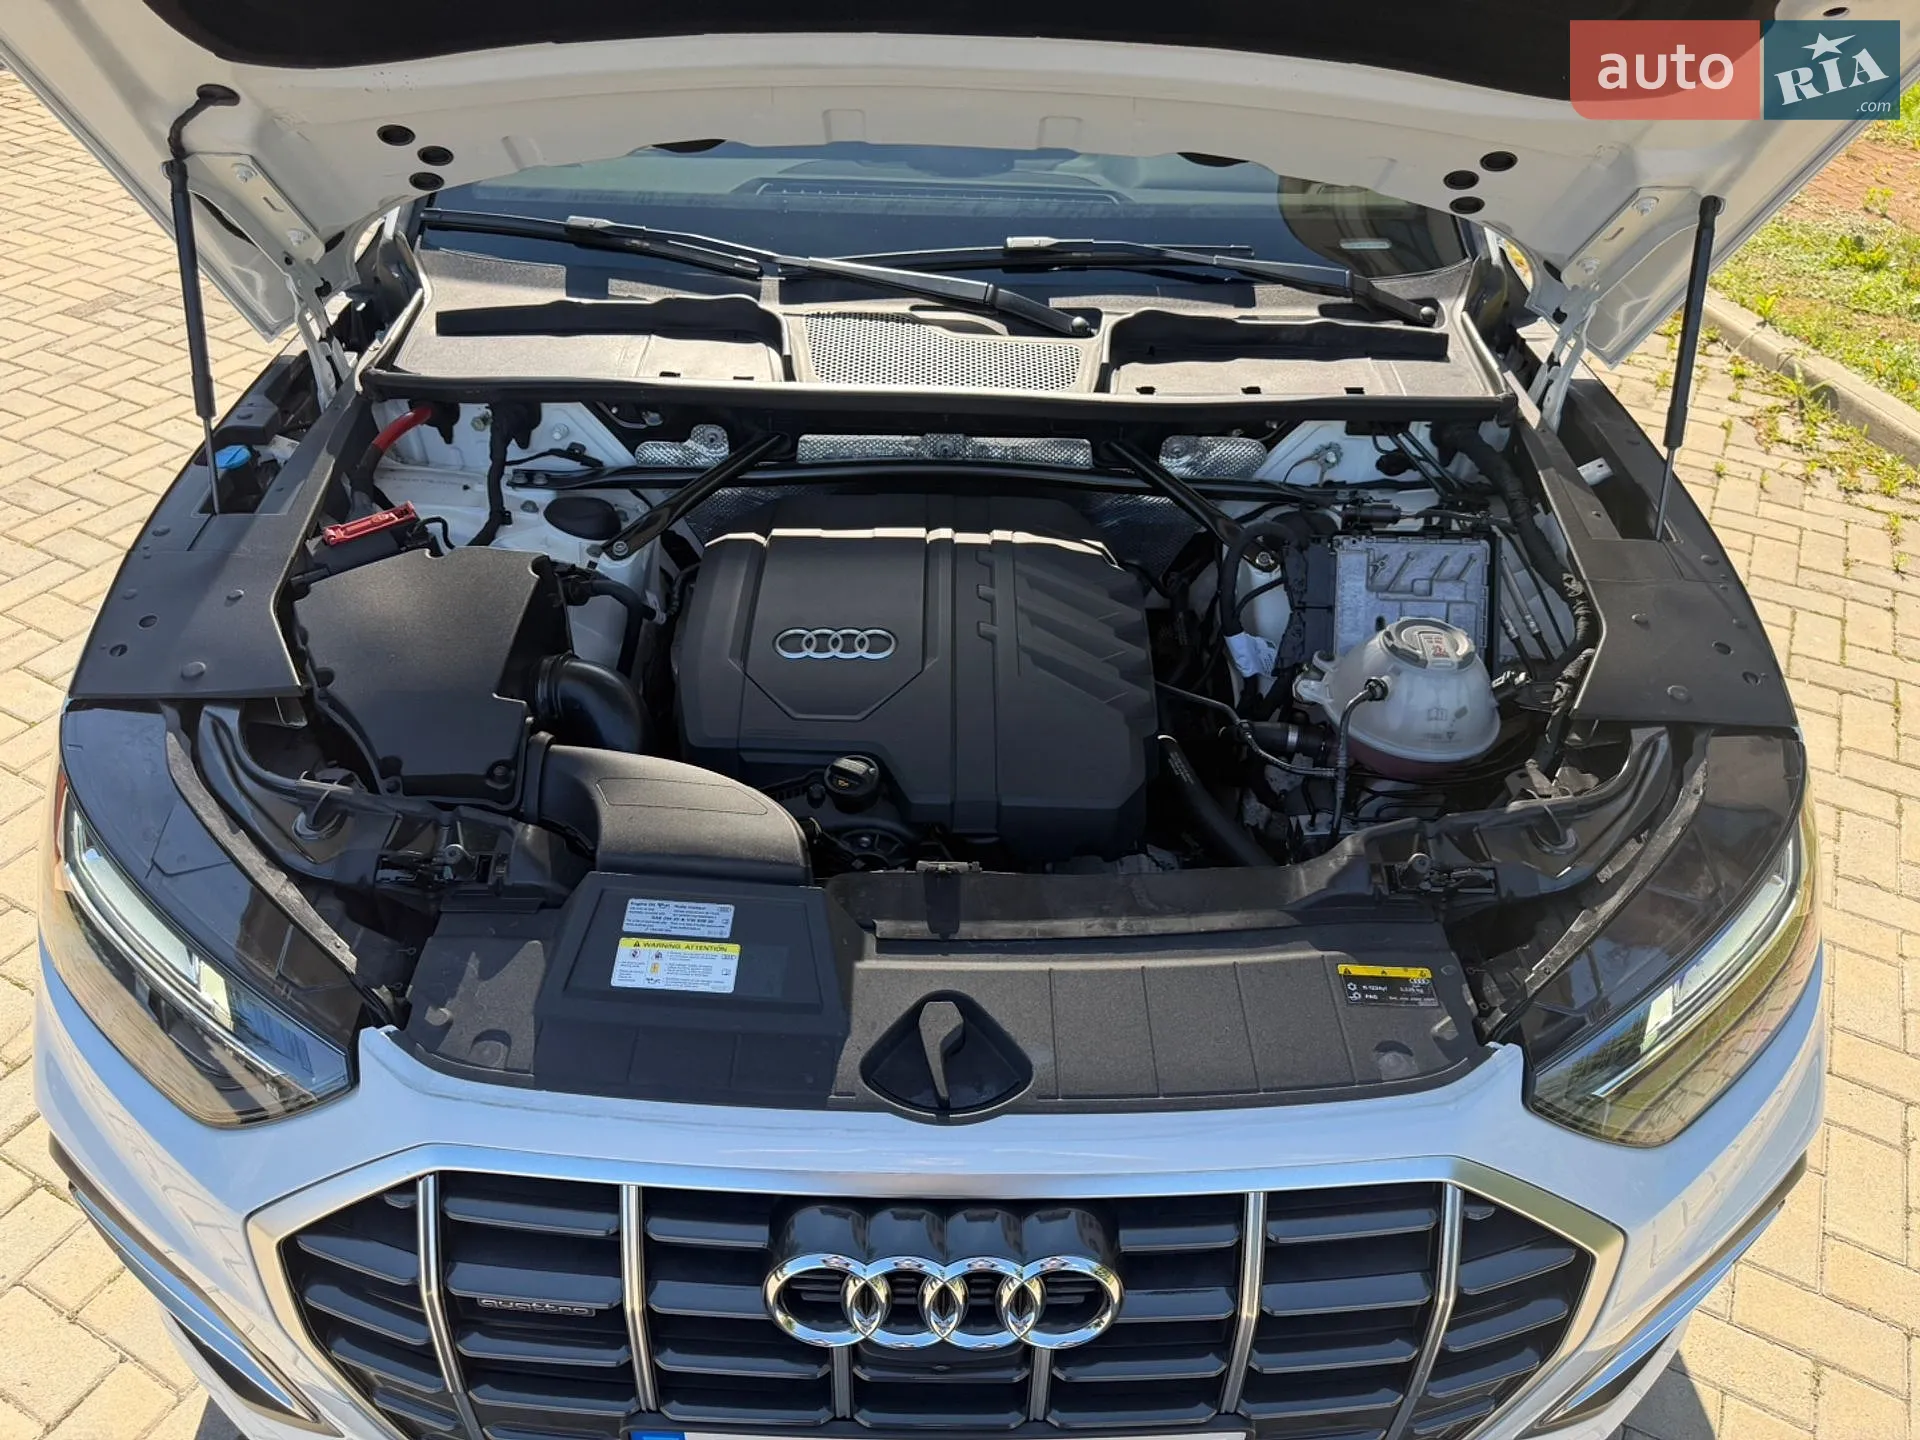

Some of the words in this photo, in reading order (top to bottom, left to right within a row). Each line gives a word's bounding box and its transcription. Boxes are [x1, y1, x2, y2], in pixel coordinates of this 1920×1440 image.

[643, 942, 682, 950] WARNING
[683, 944, 728, 953] ATTENTION
[480, 1298, 589, 1316] quattro
